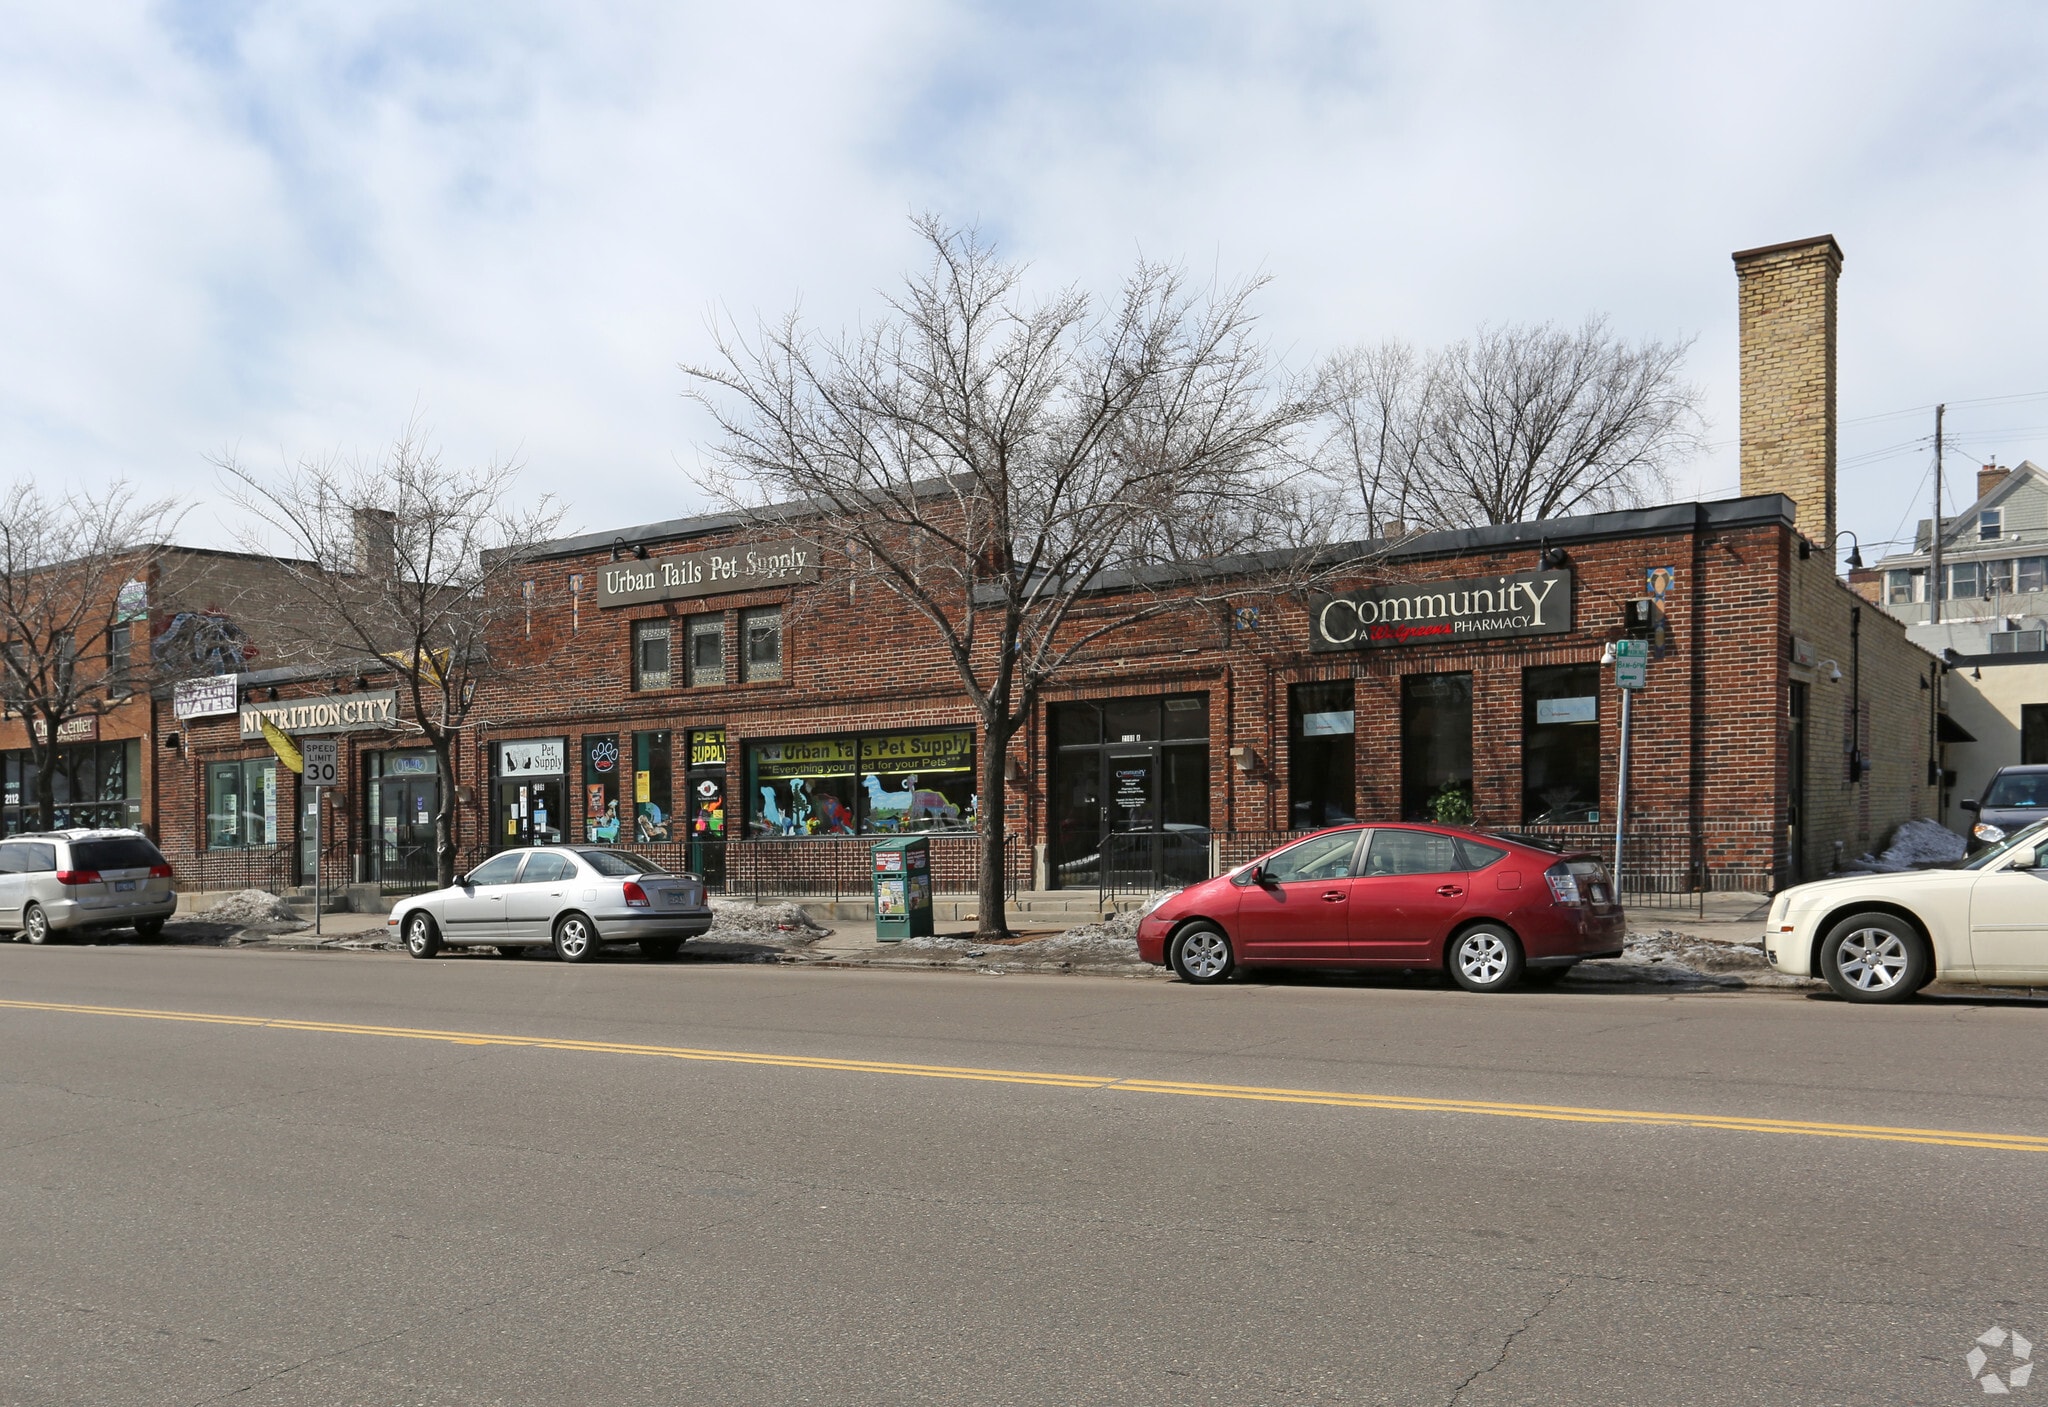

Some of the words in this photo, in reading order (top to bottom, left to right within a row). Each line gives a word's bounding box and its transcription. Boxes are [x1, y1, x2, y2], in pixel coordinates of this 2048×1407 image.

[606, 569, 655, 594] Urban
[660, 559, 701, 587] Tails
[710, 555, 737, 581] Pet
[746, 545, 807, 580] Supply
[1359, 632, 1368, 640] A
[1370, 622, 1452, 642] Walgreens
[1454, 615, 1531, 633] PHARMACY
[177, 697, 234, 715] WATER
[242, 703, 341, 733] NUTRITION
[343, 699, 391, 723] CITY
[692, 730, 725, 744] PET
[306, 744, 336, 753] SPEED
[541, 743, 554, 757] Pet
[784, 743, 831, 760] Urban
[877, 738, 906, 756] Pet
[910, 734, 968, 754] Supply
[309, 754, 332, 763] LIMIT
[534, 755, 563, 771] Supply
[826, 763, 846, 772] you
[848, 760, 875, 771] ned
[877, 759, 893, 769] for
[894, 760, 920, 771] your
[306, 763, 335, 781] 30
[4, 793, 20, 805] 2112
